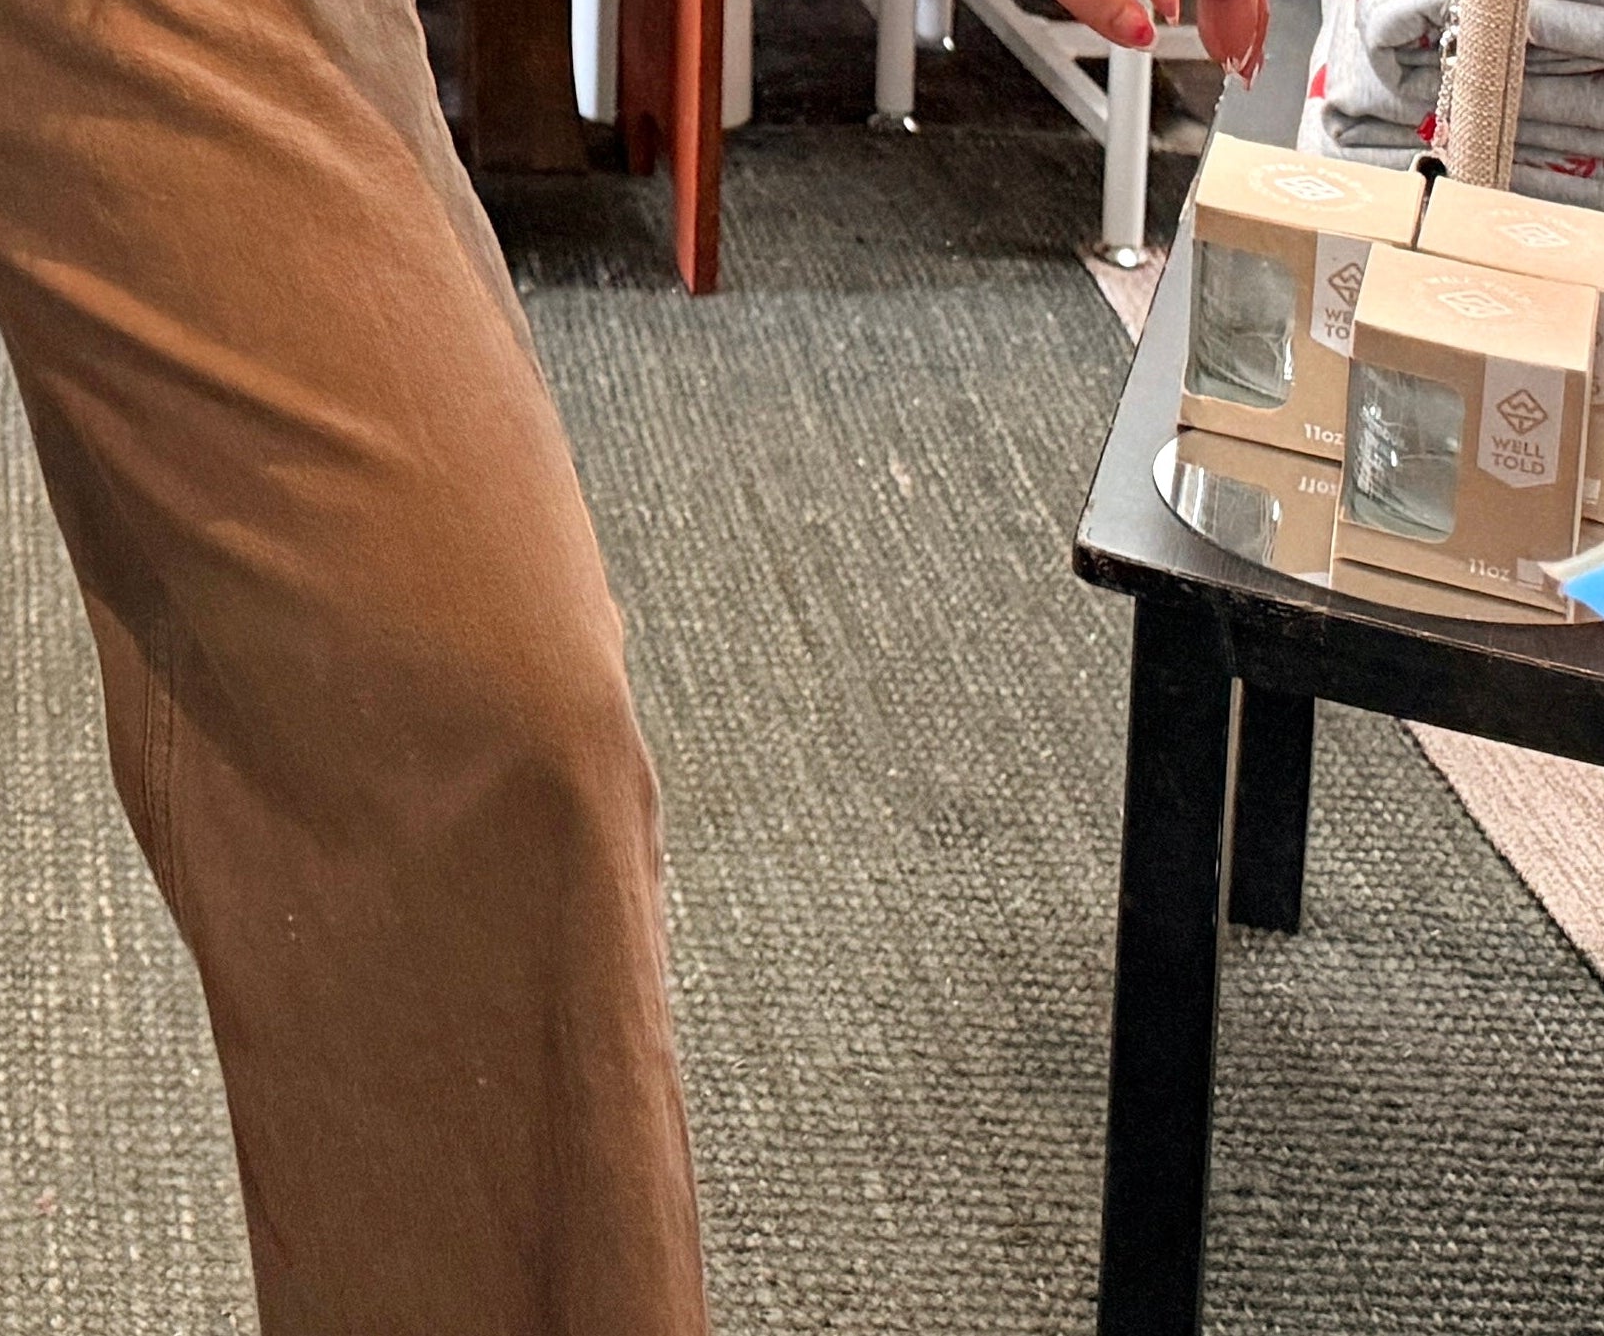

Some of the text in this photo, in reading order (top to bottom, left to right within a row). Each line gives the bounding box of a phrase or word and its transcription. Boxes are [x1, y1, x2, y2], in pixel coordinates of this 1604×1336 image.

[1304, 423, 1344, 445] 11oz
[1492, 435, 1545, 459] WELL
[1491, 452, 1545, 475] TOLD
[1469, 558, 1511, 582] 11oz
